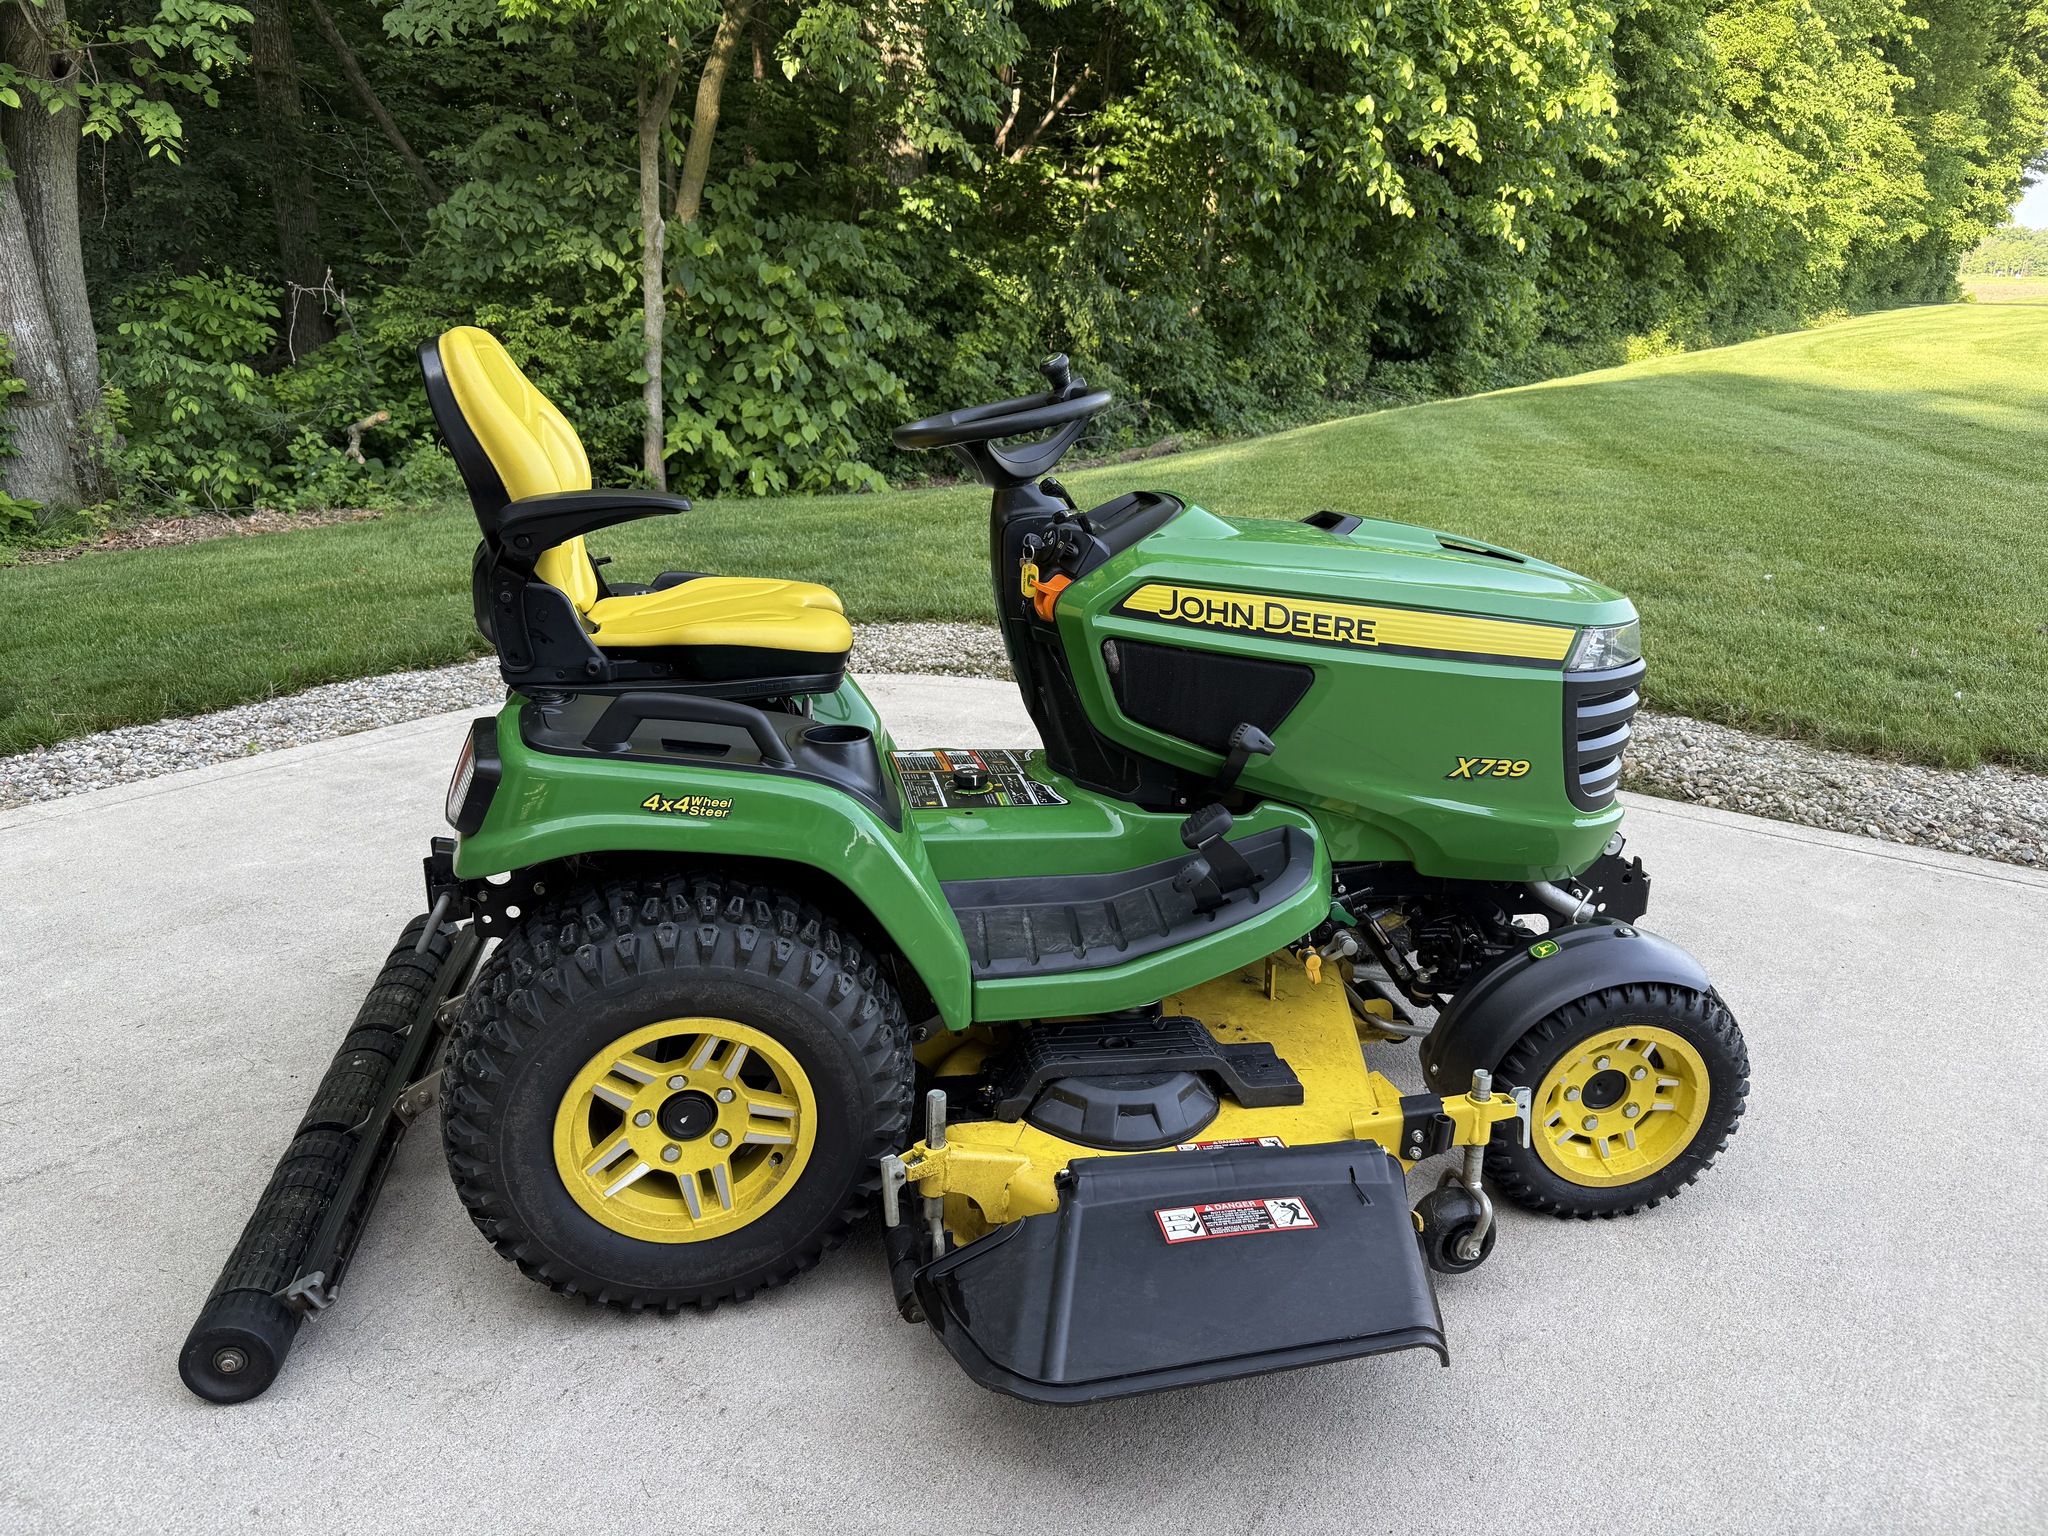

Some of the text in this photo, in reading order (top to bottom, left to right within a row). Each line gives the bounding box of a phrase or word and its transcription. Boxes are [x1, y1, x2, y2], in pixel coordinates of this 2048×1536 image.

[1159, 589, 1377, 642] JOHN DEERE
[1447, 757, 1530, 778] X739
[642, 794, 733, 813] 4x4 Wheel
[688, 806, 730, 818] Steer
[1214, 1201, 1256, 1210] DANGER
